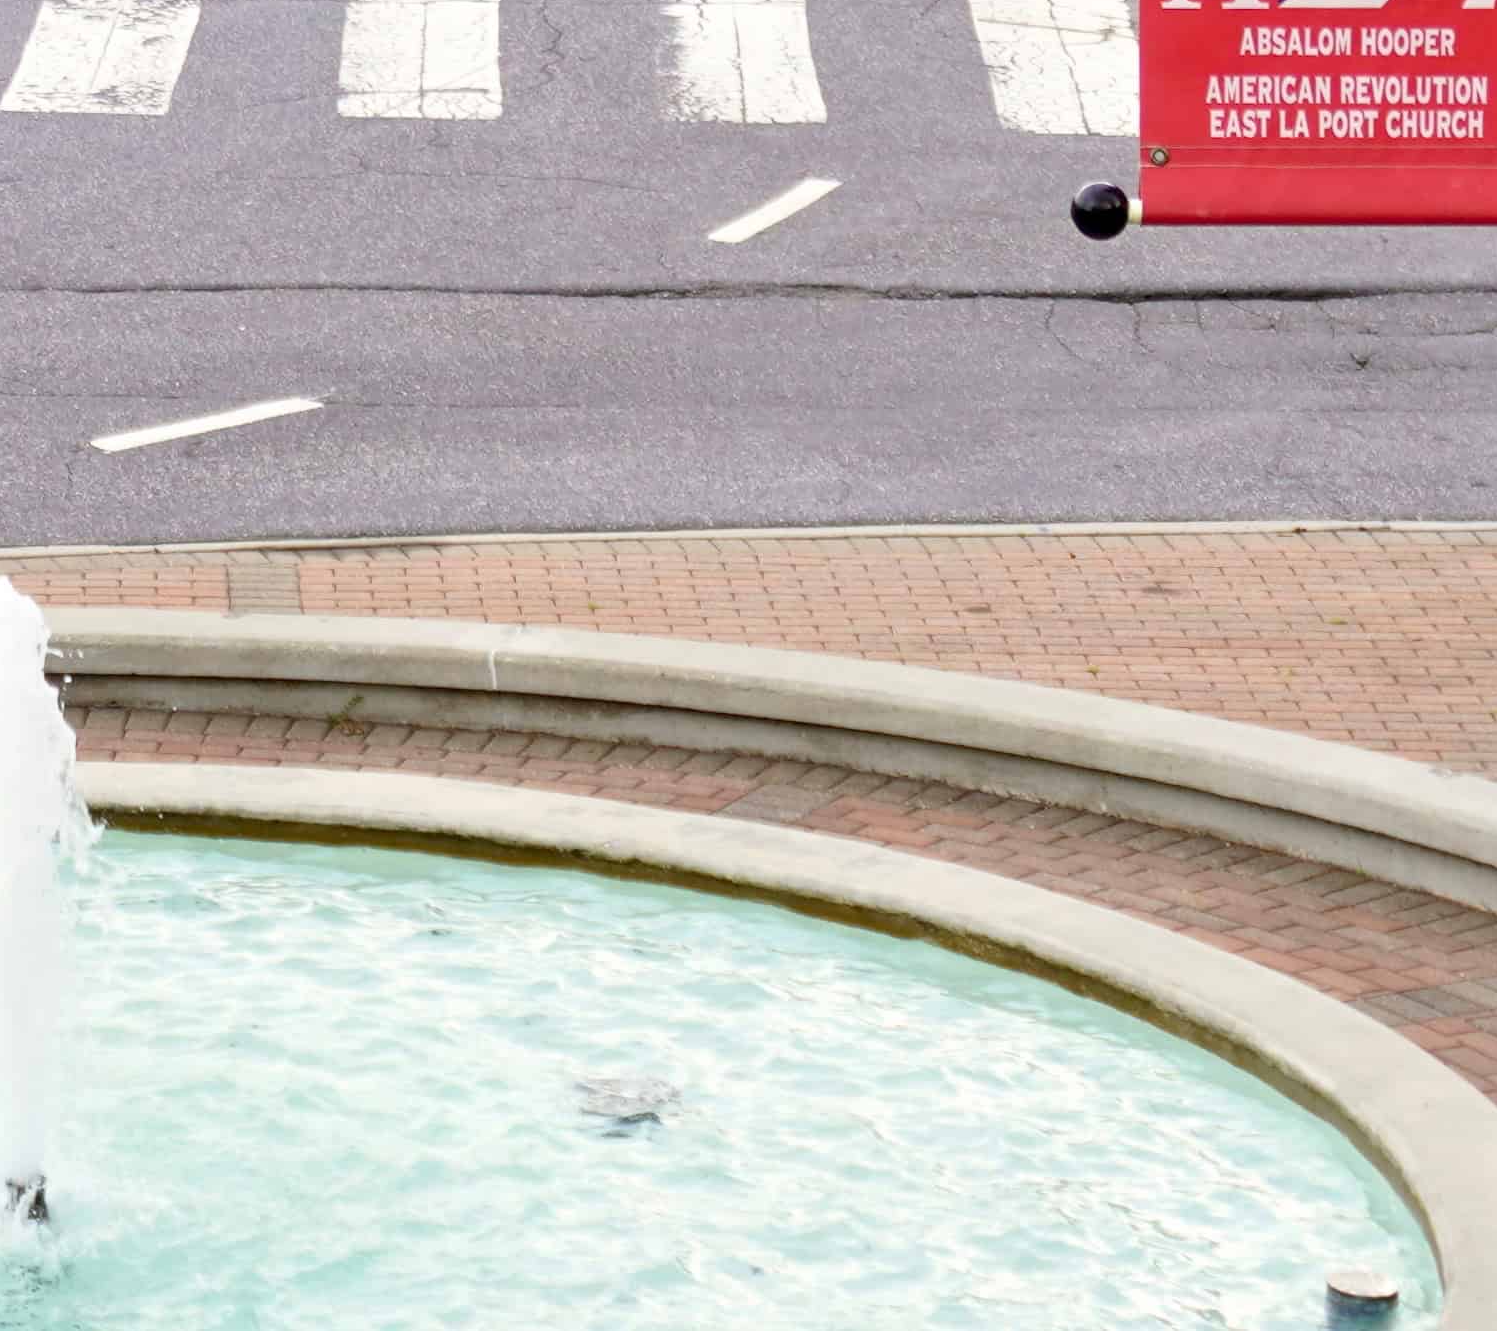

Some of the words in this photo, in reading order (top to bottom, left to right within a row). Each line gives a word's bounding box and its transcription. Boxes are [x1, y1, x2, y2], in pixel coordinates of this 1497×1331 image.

[1240, 27, 1352, 56] ABSALOM
[1361, 27, 1456, 56] HOOPER
[1206, 75, 1331, 104] AMERICAN
[1340, 75, 1488, 105] REVOLUTION
[1209, 109, 1271, 138] EAST
[1279, 109, 1310, 138] LA
[1318, 109, 1379, 138] PORT
[1385, 109, 1485, 138] CHURCH
